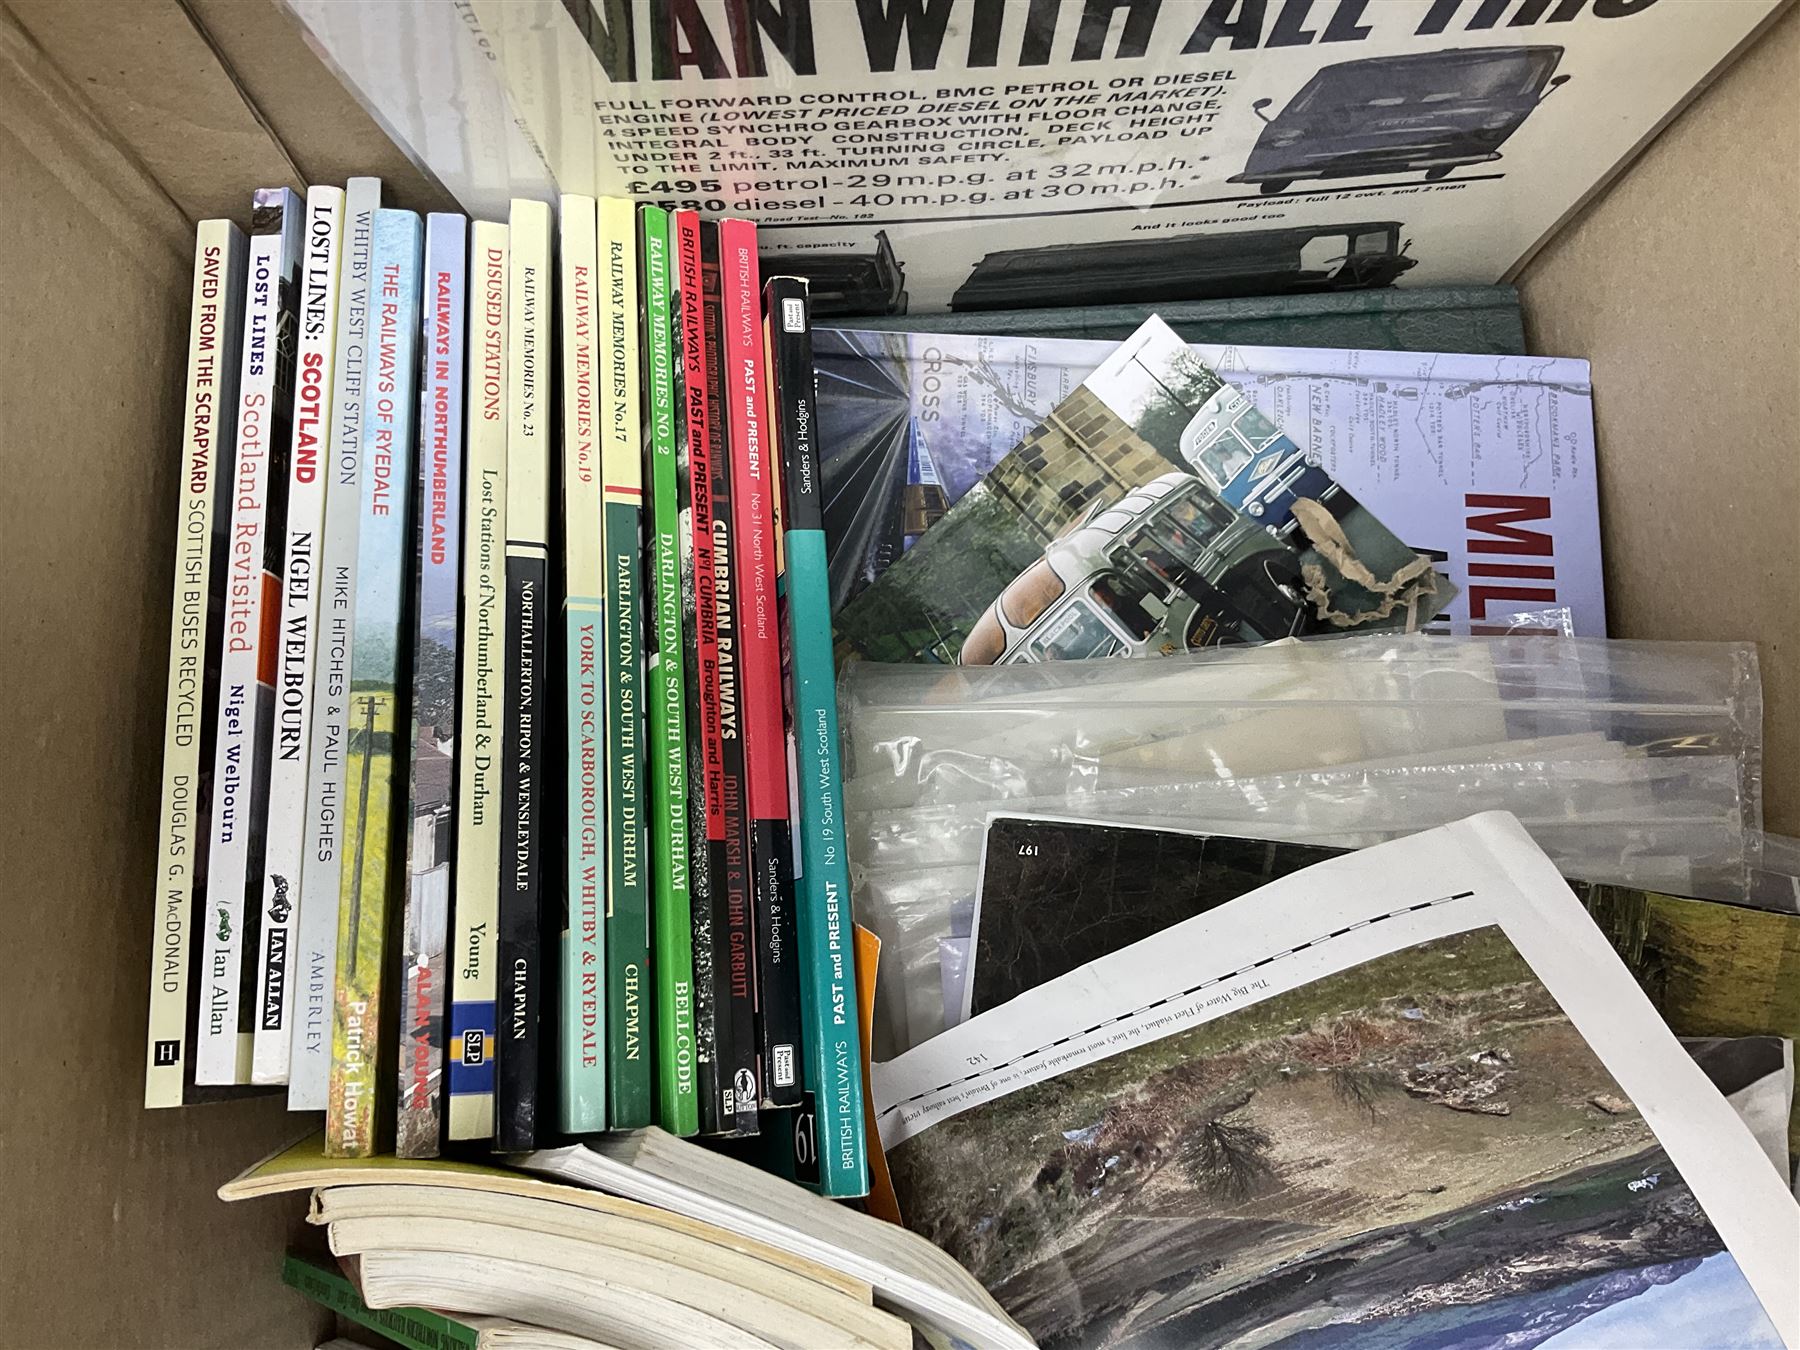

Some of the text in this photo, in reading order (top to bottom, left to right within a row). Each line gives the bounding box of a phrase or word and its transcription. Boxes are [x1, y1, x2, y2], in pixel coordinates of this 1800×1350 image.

[559, 0, 817, 83] VAN
[856, 0, 1155, 73] WITH
[594, 100, 656, 111] FULL
[661, 95, 792, 109] FORWARD
[936, 86, 995, 99] BMC
[1004, 80, 1099, 95] PETROL
[1108, 77, 1145, 88] OR
[1153, 70, 1237, 87] DIESEL
[628, 179, 722, 194] £495
[1131, 222, 1161, 231] And
[1181, 218, 1219, 227] looks
[1221, 215, 1258, 225] good
[1354, 191, 1386, 199] cwt.
[250, 255, 270, 376] LOST LINES
[575, 265, 590, 340] RAILWAY
[611, 240, 624, 308] RAILWAY
[191, 246, 220, 494] SAVED FROM THE SCRAPYARD
[296, 206, 333, 483] LOST LINES: SCOTLAND
[340, 210, 371, 486] WHITBY WEST CLIFF STATION
[483, 248, 503, 421] DISUSED STATIONS
[523, 267, 535, 436] RAILWAY MEMORIES No. 23
[612, 311, 627, 398] MEMORIES
[373, 264, 400, 516] THE RAILWAYS OF RYEDALE
[431, 272, 451, 565] RAILWAYS IN NORTHUMBERLAND
[576, 343, 592, 437] MEMORIES
[681, 226, 709, 535] BRITISH RAILWAYS PAST and PRESENT
[921, 346, 942, 423] CROSS
[228, 394, 265, 653] Scotland Revisited
[751, 493, 761, 510] No
[753, 529, 765, 561] North
[754, 563, 766, 592] West
[176, 499, 206, 747] SCOTTISH BUSES RECYCLED
[280, 532, 312, 762] NIGEL WELBOURN
[473, 469, 498, 826] Lost Stations of Northumberland & Durham
[580, 624, 594, 676] YORK
[700, 574, 715, 645] CUMBRIA
[713, 519, 736, 741] CUMBRIAN RAILWAYS
[755, 594, 768, 639] Scotland
[317, 566, 350, 862] MIKE HITCHES & PAUL HUGHES
[519, 713, 532, 759] RIPON
[580, 681, 594, 706] TO
[618, 553, 637, 887] DARLINGTON & SOUTH WEST DURHAM
[221, 685, 244, 844] Nigel Welbourn
[519, 762, 531, 774] &
[703, 659, 723, 816] Broughton and Harris
[169, 775, 189, 856] DOUGLAS
[815, 708, 836, 865] No 19 South West Scotland
[168, 864, 185, 881] G.
[516, 777, 531, 891] WENSLEYDALE
[1018, 845, 1039, 856] 197
[581, 866, 597, 946] WHITBY
[210, 949, 231, 1036] Ian Allan
[264, 931, 288, 1028] IAN ALLAN
[463, 922, 487, 979] Young
[582, 950, 597, 965] &
[1231, 985, 1249, 997] Big
[1251, 978, 1271, 991] The
[306, 951, 325, 1054] AMBERLEY
[412, 966, 431, 1109] ALAN YOUNG
[513, 958, 526, 1040] CHAPMAN
[582, 970, 597, 1069] RYEDALE
[625, 963, 640, 1061] CHAPMAN
[674, 981, 692, 1095] BELLCODE
[826, 881, 854, 1169] BRITISH RAILWAYS PAST and PRESENT
[1174, 1006, 1196, 1020] Fleet
[1196, 1002, 1205, 1014] of
[1206, 993, 1232, 1006] Water
[342, 1001, 366, 1149] Patrick Howat
[467, 1032, 481, 1062] SLP
[966, 1052, 988, 1065] 142
